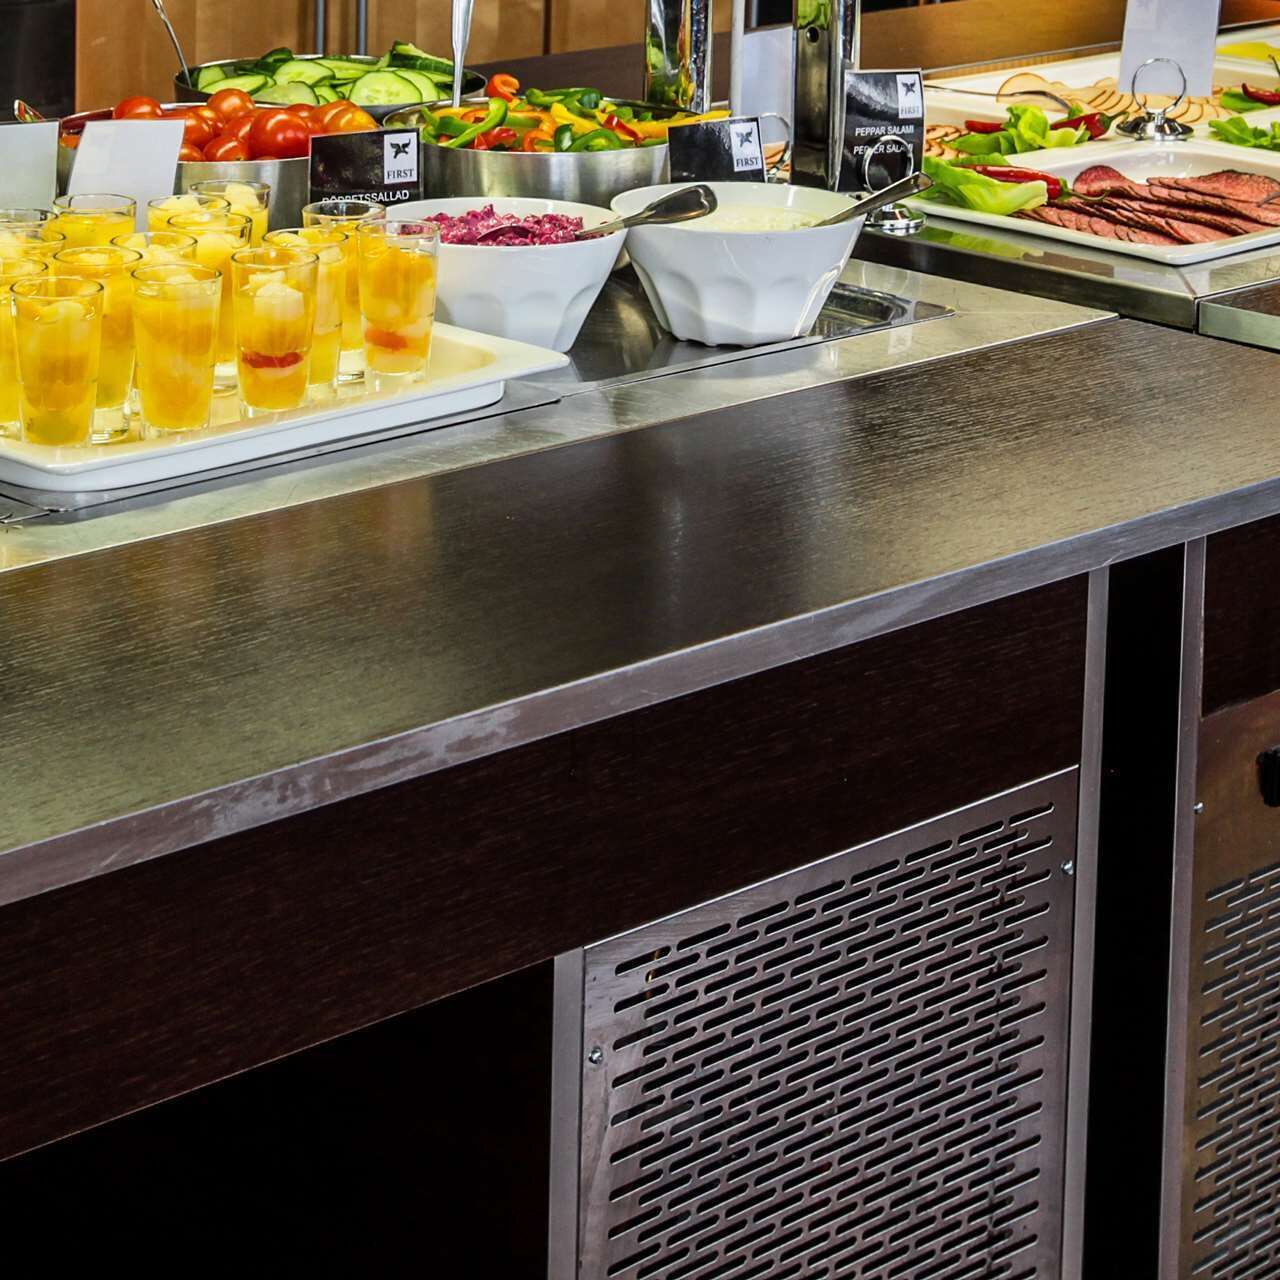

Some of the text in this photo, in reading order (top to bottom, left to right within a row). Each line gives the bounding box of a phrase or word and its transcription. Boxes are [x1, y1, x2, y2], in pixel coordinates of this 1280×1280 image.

[855, 124, 914, 136] PEPPAR SALAMI
[736, 157, 759, 167] FIRST
[387, 168, 415, 179] FIRST
